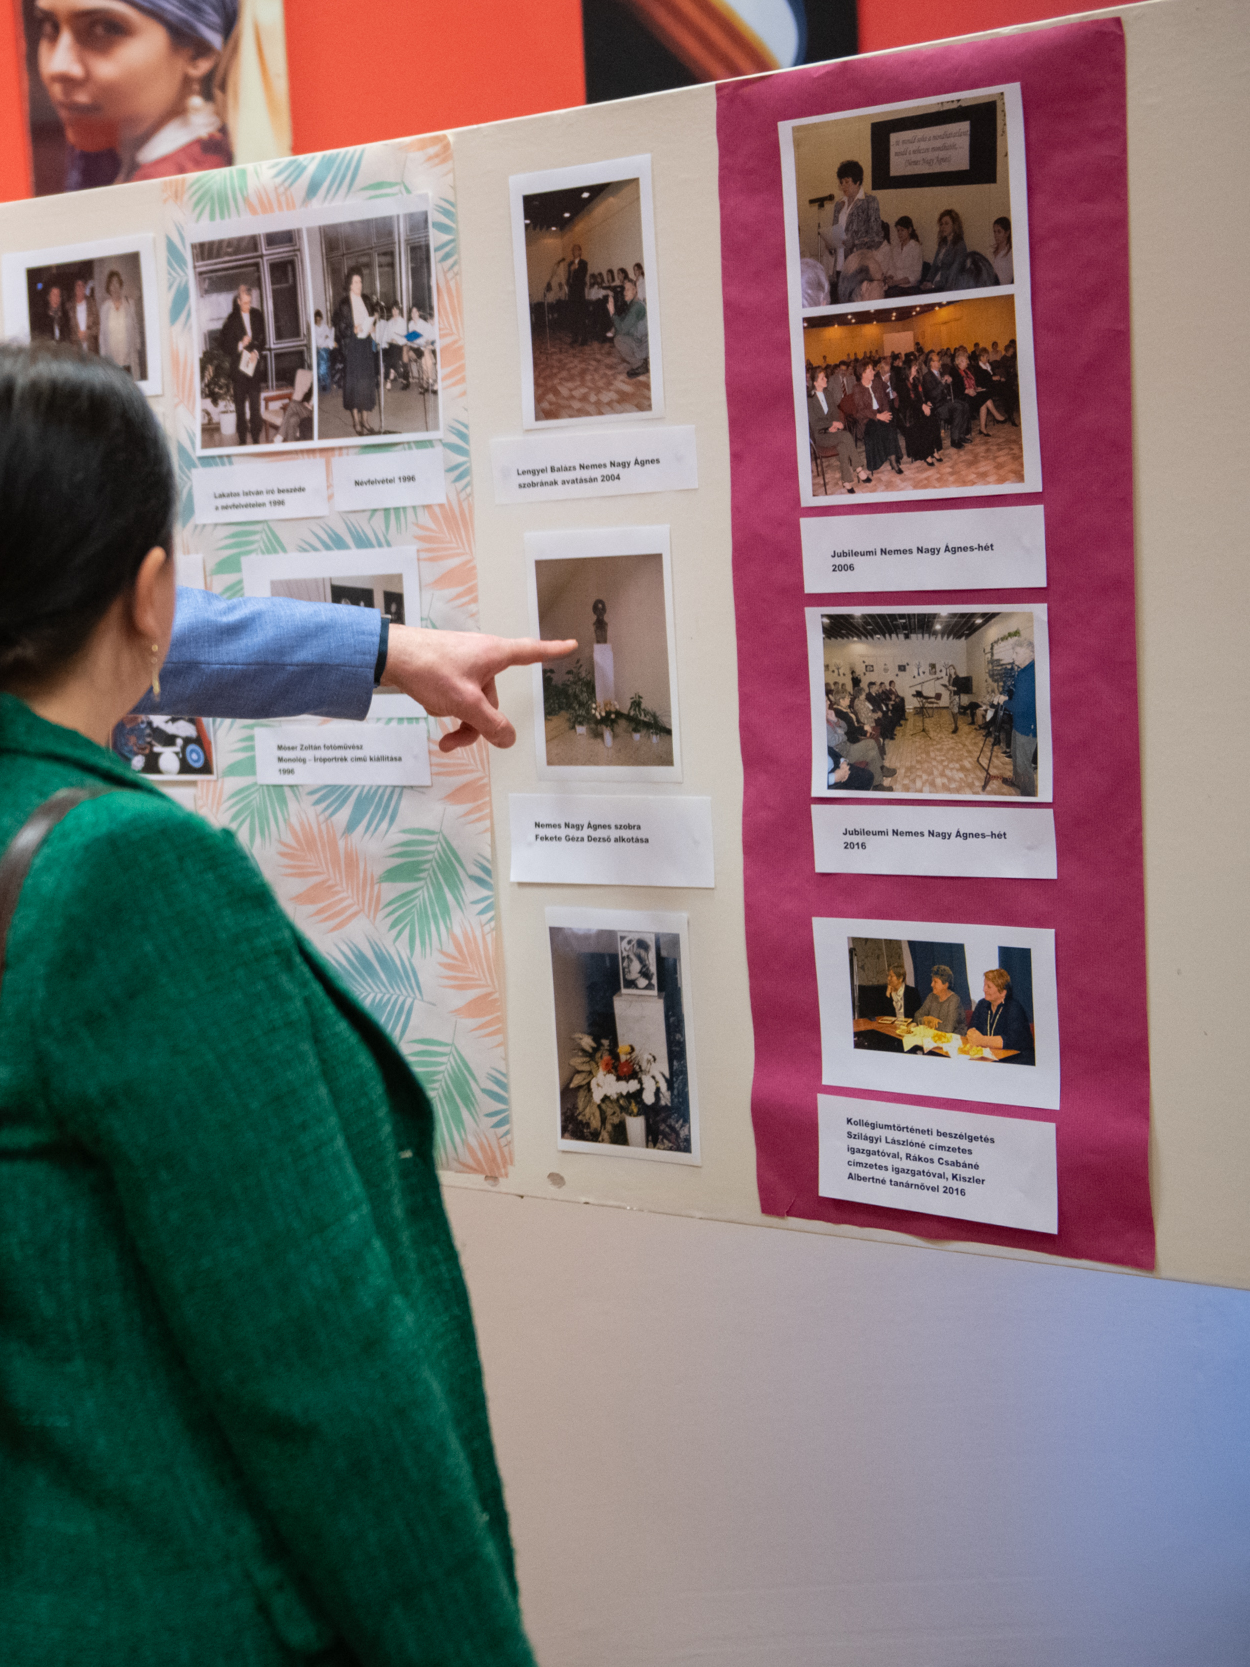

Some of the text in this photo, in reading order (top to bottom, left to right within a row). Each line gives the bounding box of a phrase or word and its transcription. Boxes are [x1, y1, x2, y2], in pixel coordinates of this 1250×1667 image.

[517, 456, 661, 477] Lengyel Balázs Nemes Nagy Ágnes
[354, 475, 416, 487] Névfelvétel 1996
[518, 473, 621, 489] szobrának avatásán 2004
[214, 491, 241, 499] Lakatos
[242, 488, 264, 497] István
[277, 485, 306, 494] beszéde
[269, 499, 285, 507] 1996
[831, 543, 994, 559] Jubileumi Nemes Nagy Ágnes-hét
[831, 563, 855, 572] 2006
[300, 743, 322, 751] Zoltán
[534, 820, 641, 832] Nemes Nagy Ágnes szobra
[535, 834, 562, 842] Fekete
[564, 834, 585, 843] Géza
[614, 835, 649, 844] alkotása
[842, 827, 889, 837] Jubileumi
[892, 829, 925, 838] Nemes
[928, 829, 952, 840] Nagy
[843, 841, 867, 850] 2016
[846, 1117, 995, 1144] Kollégiumtörténeti beszélgetés
[846, 1131, 973, 1155] Szilágyi Lászlóné címzetes
[847, 1145, 980, 1170] igazgatóval, Rákos Csabáné
[847, 1159, 986, 1185] címzetes igazgatóval, Kiszler
[847, 1172, 887, 1185] Albertné
[942, 1186, 966, 1197] 2016
